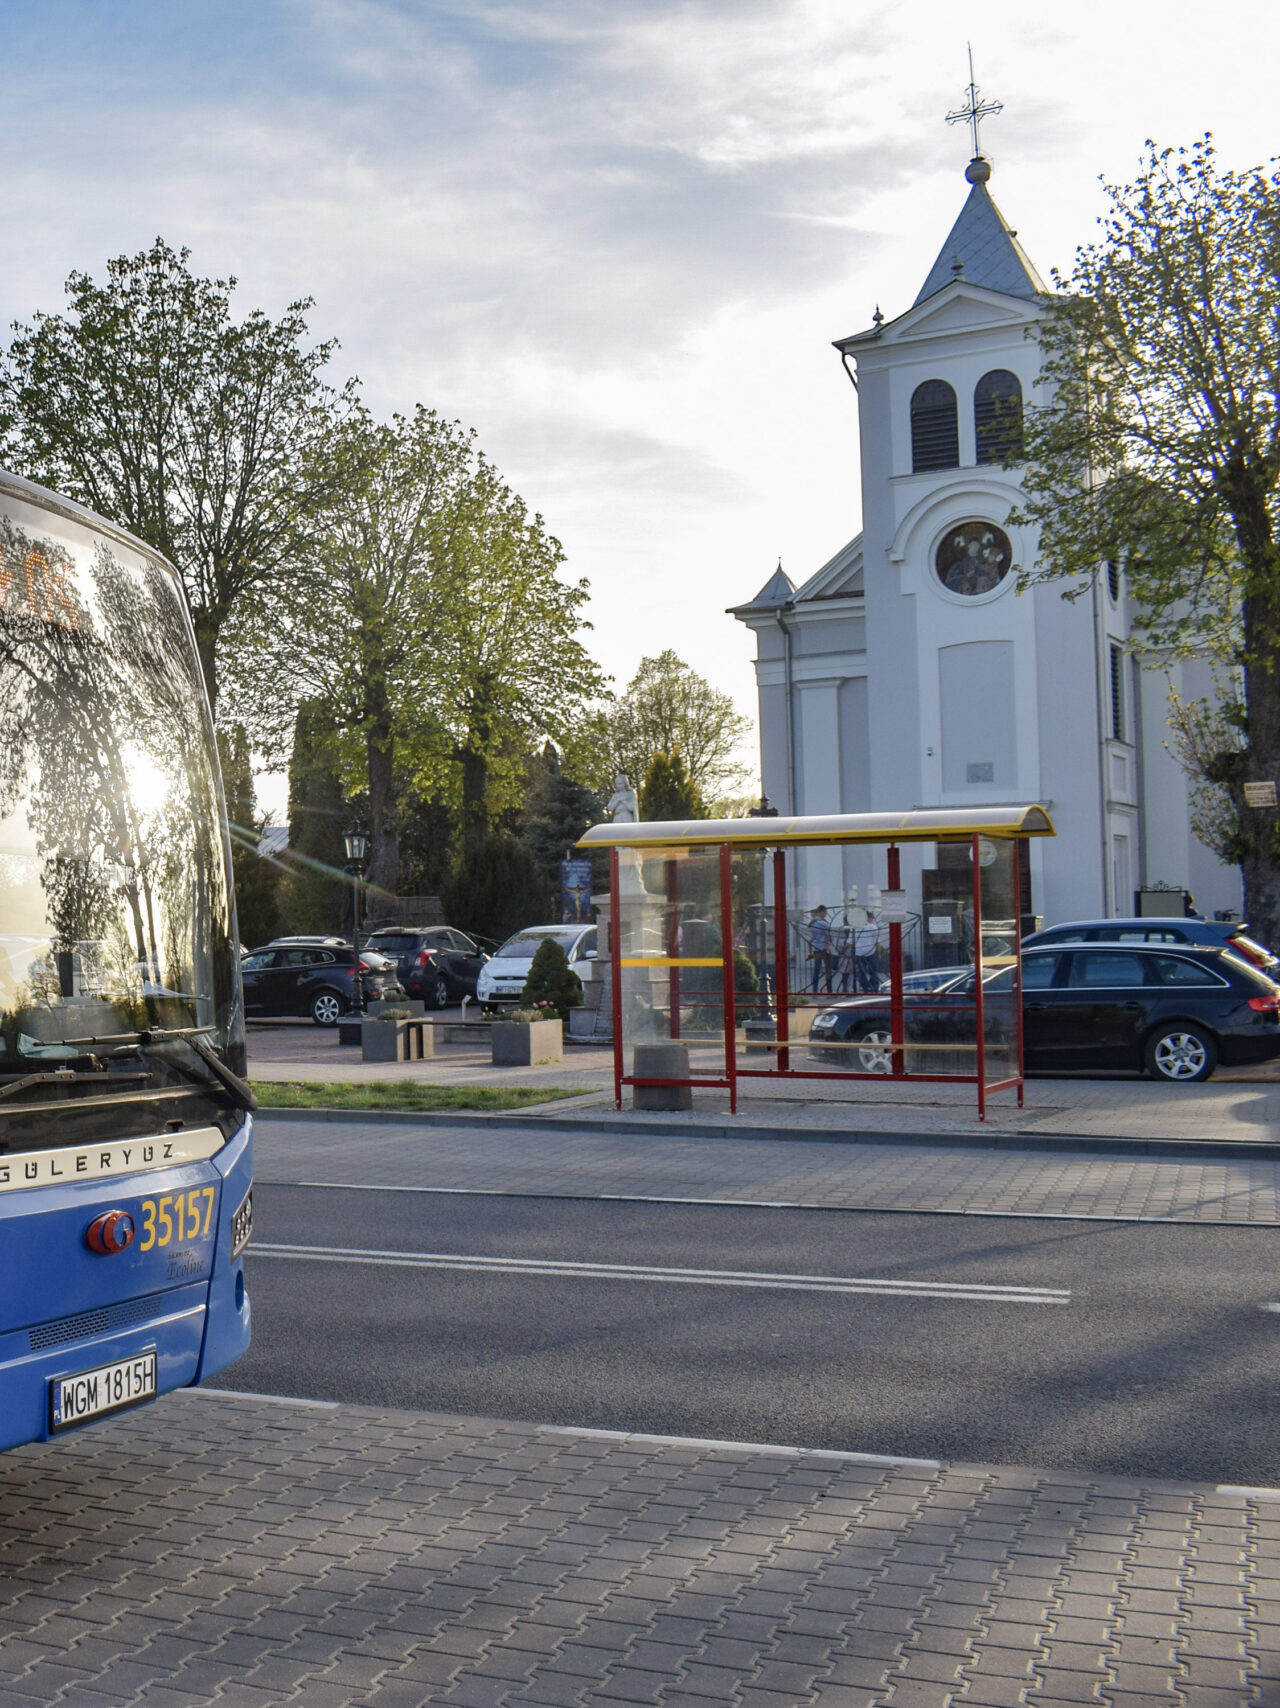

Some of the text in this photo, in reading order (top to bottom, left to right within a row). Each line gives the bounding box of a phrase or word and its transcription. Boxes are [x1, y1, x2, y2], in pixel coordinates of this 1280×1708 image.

[140, 1187, 214, 1251] 35157
[167, 1253, 204, 1280] Ecoline
[63, 1358, 154, 1419] WGM 1815H
